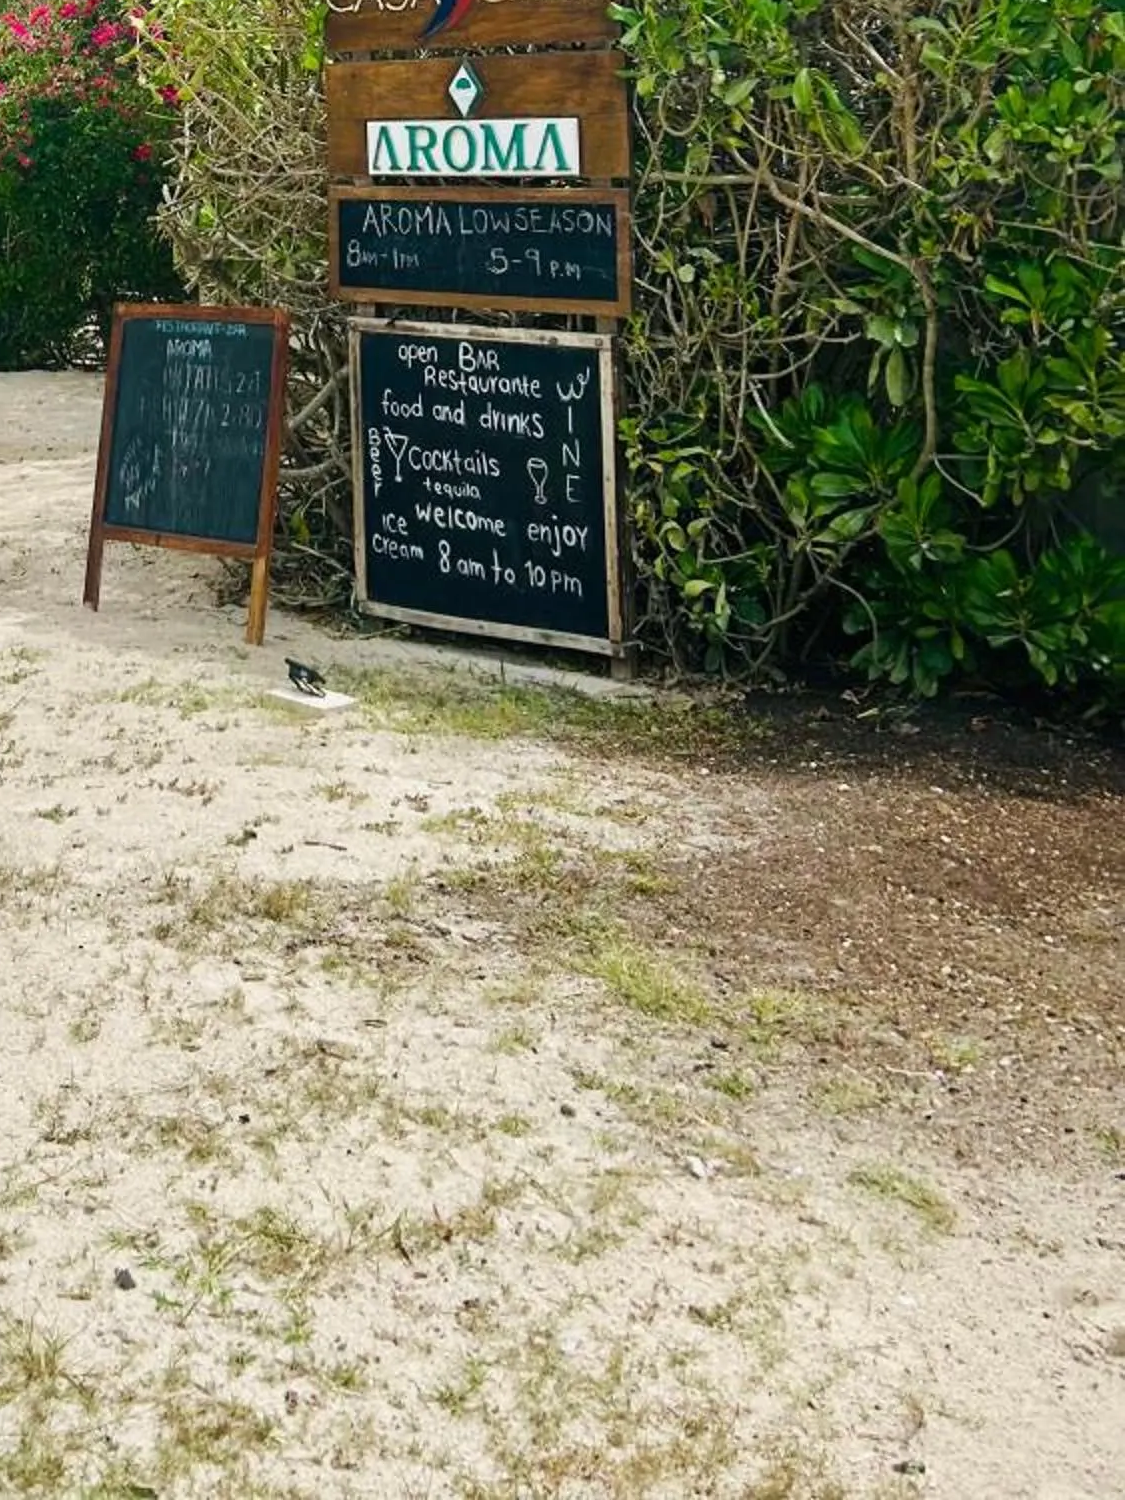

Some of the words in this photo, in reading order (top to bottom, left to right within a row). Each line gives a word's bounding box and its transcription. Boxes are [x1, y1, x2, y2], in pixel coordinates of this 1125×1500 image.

[373, 122, 573, 173] AROMA
[362, 203, 452, 237] AROMA
[167, 339, 213, 358] AROMA
[424, 365, 543, 399] Restaurante
[381, 388, 424, 418] food
[432, 399, 466, 426] and
[423, 476, 482, 501] tequila
[438, 539, 451, 573] 8
[456, 557, 486, 581] am
[491, 548, 516, 584] to
[524, 559, 546, 587] 10
[550, 570, 584, 597] pm
